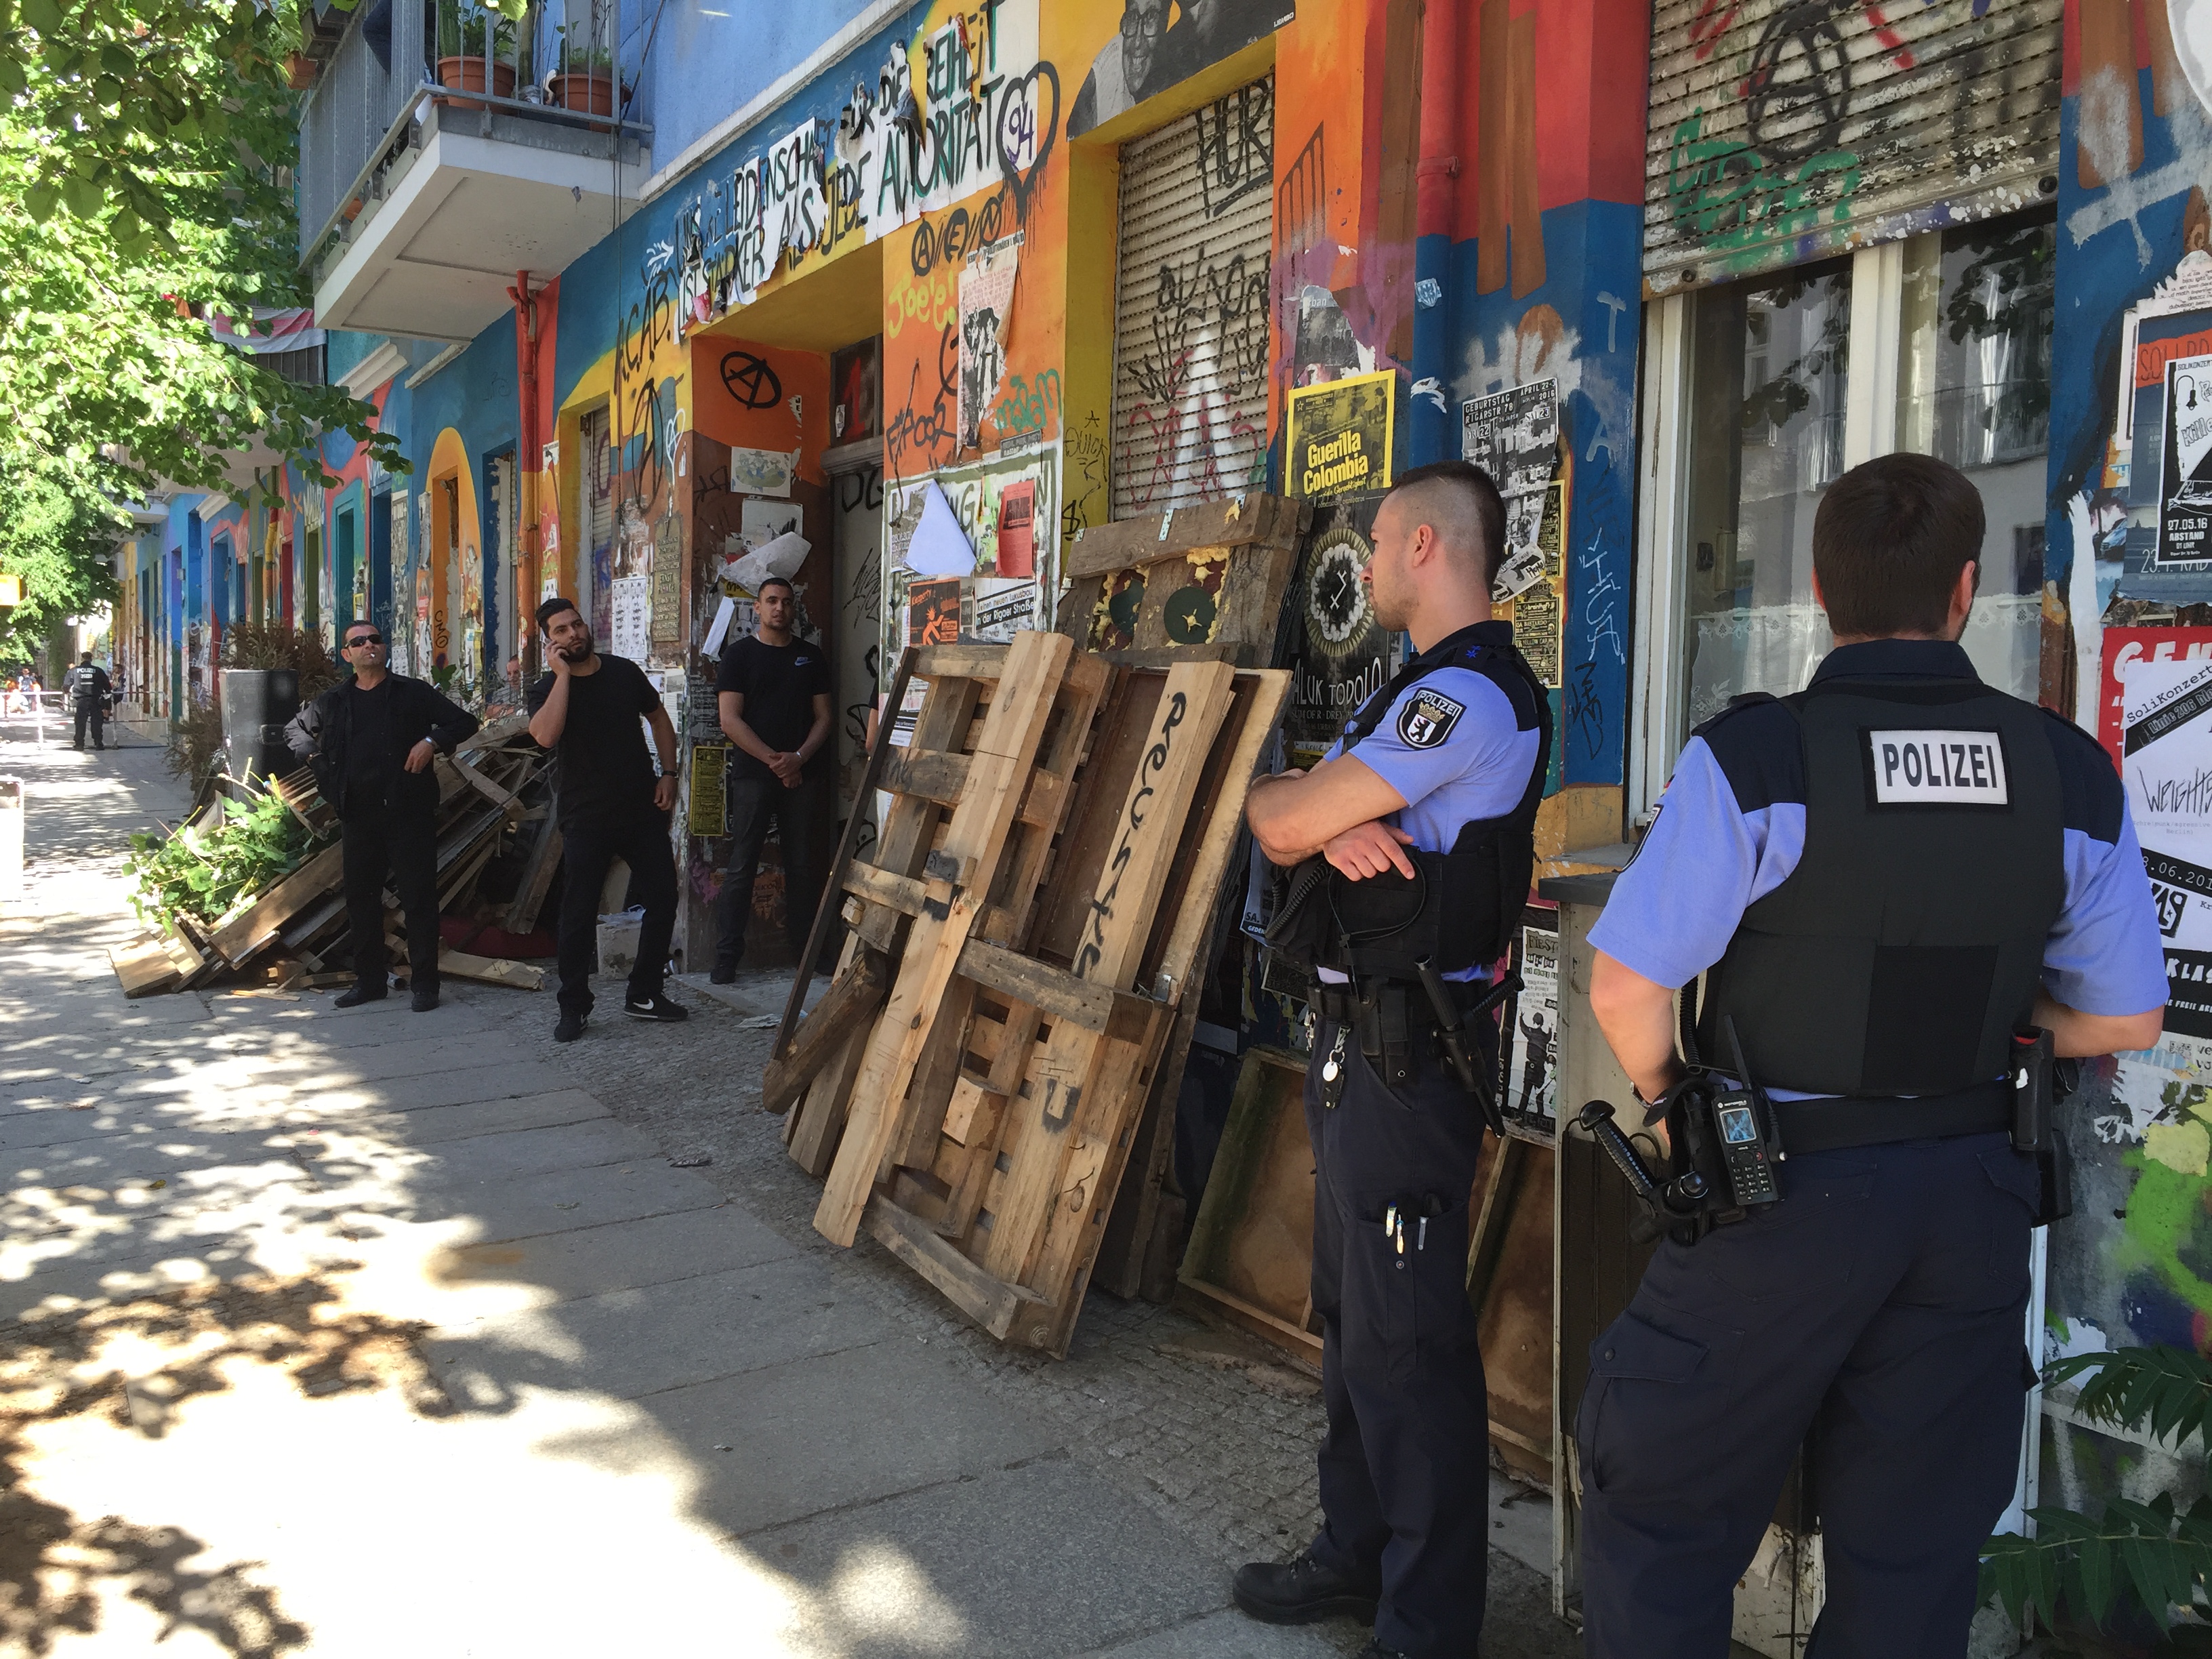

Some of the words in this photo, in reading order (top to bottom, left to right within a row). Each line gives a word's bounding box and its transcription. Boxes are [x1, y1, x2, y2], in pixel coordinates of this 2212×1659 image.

[1520, 384, 1540, 396] APRIL
[1539, 390, 1555, 401] 2016
[1479, 426, 1490, 437] 22
[1307, 430, 1361, 469] Guerilla
[1303, 453, 1369, 495] Colombia
[2168, 517, 2208, 531] 27.05.16
[2169, 531, 2205, 541] ABSTAND
[983, 613, 991, 624] der
[994, 607, 1012, 621] Rigaer
[1013, 599, 1035, 614] Straße
[1292, 658, 1324, 705] ALUK
[1328, 657, 1382, 706] TODOLO
[1417, 692, 1459, 717] POLIZEI
[2174, 698, 2197, 720] 206
[1882, 743, 1997, 788] POLIZEI
